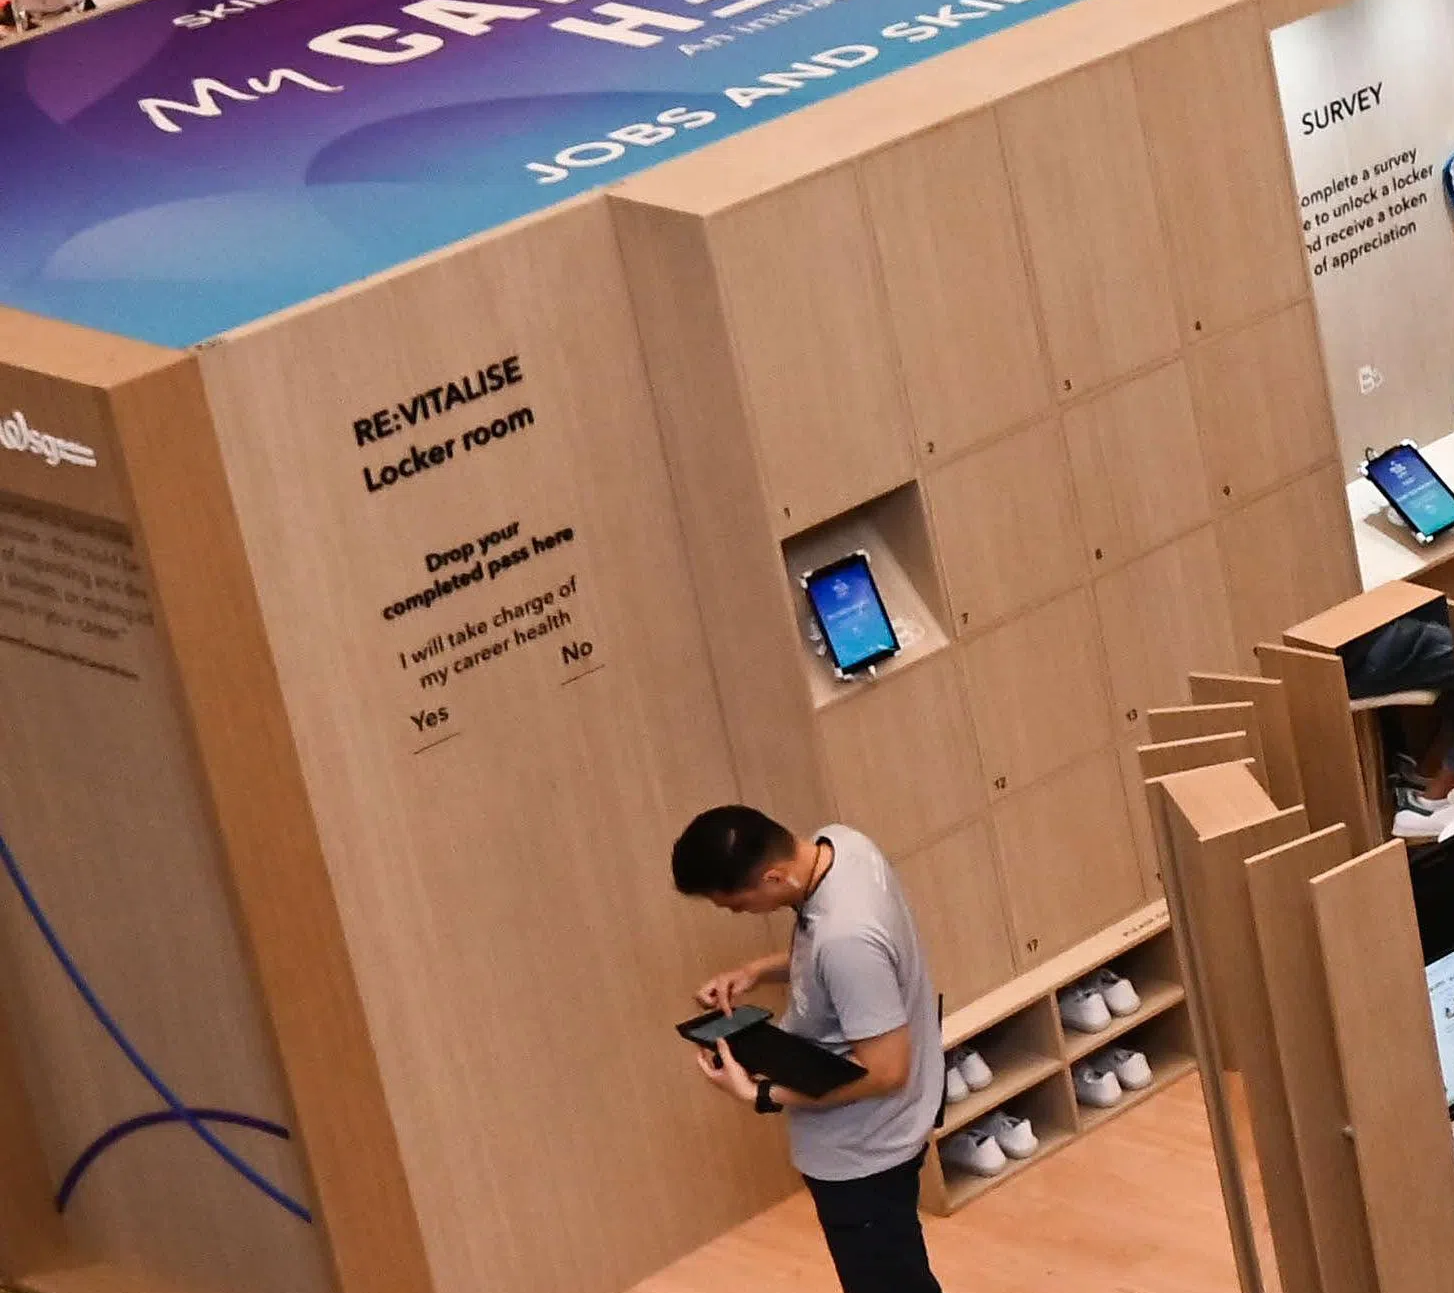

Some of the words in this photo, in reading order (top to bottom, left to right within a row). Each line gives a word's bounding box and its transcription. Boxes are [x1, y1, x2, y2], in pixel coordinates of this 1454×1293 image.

[137, 67, 345, 135] My
[524, 107, 719, 186] JOBS
[722, 41, 882, 109] AND
[1301, 81, 1384, 136] SURVEY
[1315, 213, 1330, 228] to
[1333, 191, 1379, 222] unlock
[1381, 186, 1391, 199] a
[1392, 163, 1435, 196] locker
[1361, 168, 1371, 182] a
[1373, 146, 1418, 179] survey
[1314, 255, 1330, 276] of
[1332, 220, 1417, 269] appreciation
[1325, 217, 1375, 246] receive
[1377, 209, 1387, 222] a
[1389, 191, 1428, 218] token
[353, 355, 525, 447] RE:VITALISE
[363, 438, 456, 492] Locker
[462, 407, 536, 452] room
[381, 560, 484, 620] completed
[488, 547, 530, 581] pass
[532, 525, 575, 556] here
[425, 541, 475, 574] Drop
[478, 520, 520, 553] your
[399, 652, 408, 669] I
[410, 637, 445, 665] will
[448, 622, 488, 650] take
[492, 591, 555, 629] charge
[558, 575, 578, 604] of
[418, 665, 450, 691] my
[452, 639, 511, 674] career
[514, 611, 572, 646] health
[561, 640, 594, 665] No
[411, 705, 450, 733] Yes
